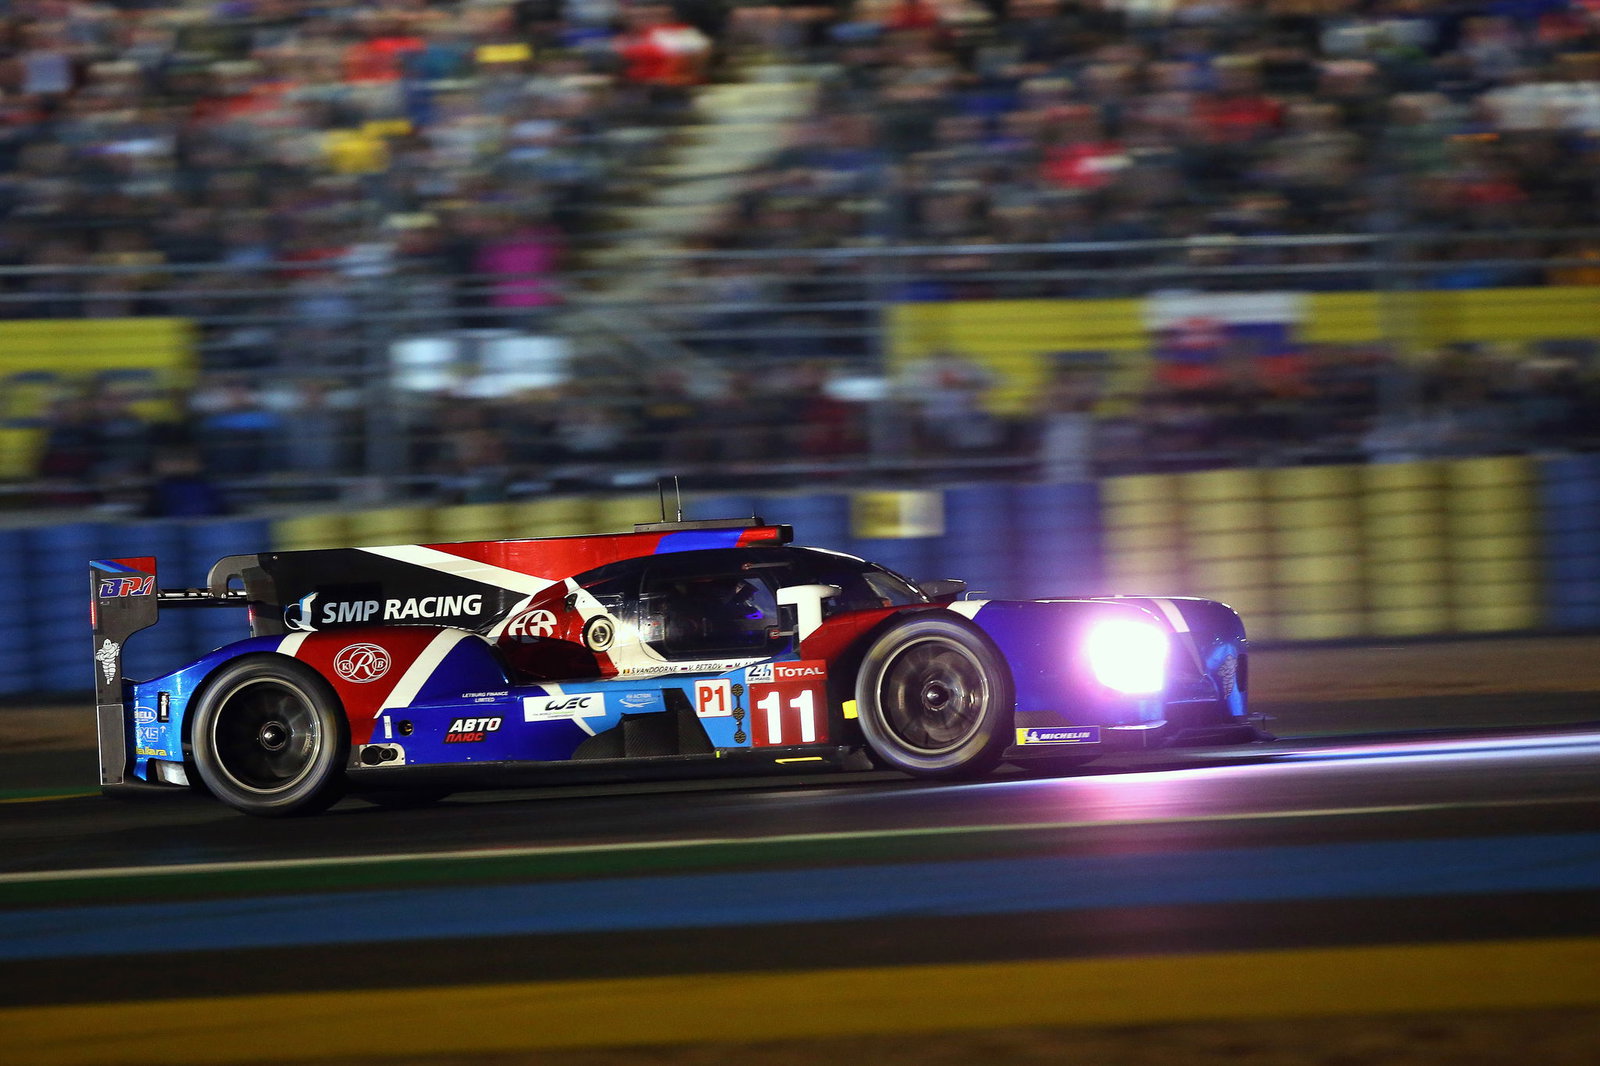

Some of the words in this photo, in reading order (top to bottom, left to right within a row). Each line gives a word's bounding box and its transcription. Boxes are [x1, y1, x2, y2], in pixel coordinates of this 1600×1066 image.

[321, 600, 380, 624] SMP
[383, 594, 482, 620] RACING
[775, 666, 825, 678] TOTAL
[545, 697, 592, 711] WEC
[699, 686, 725, 713] P1
[757, 689, 816, 744] 11
[449, 717, 501, 733] АВТО
[445, 732, 485, 743] ПЛЮС
[1040, 731, 1091, 740] MICHELIN
